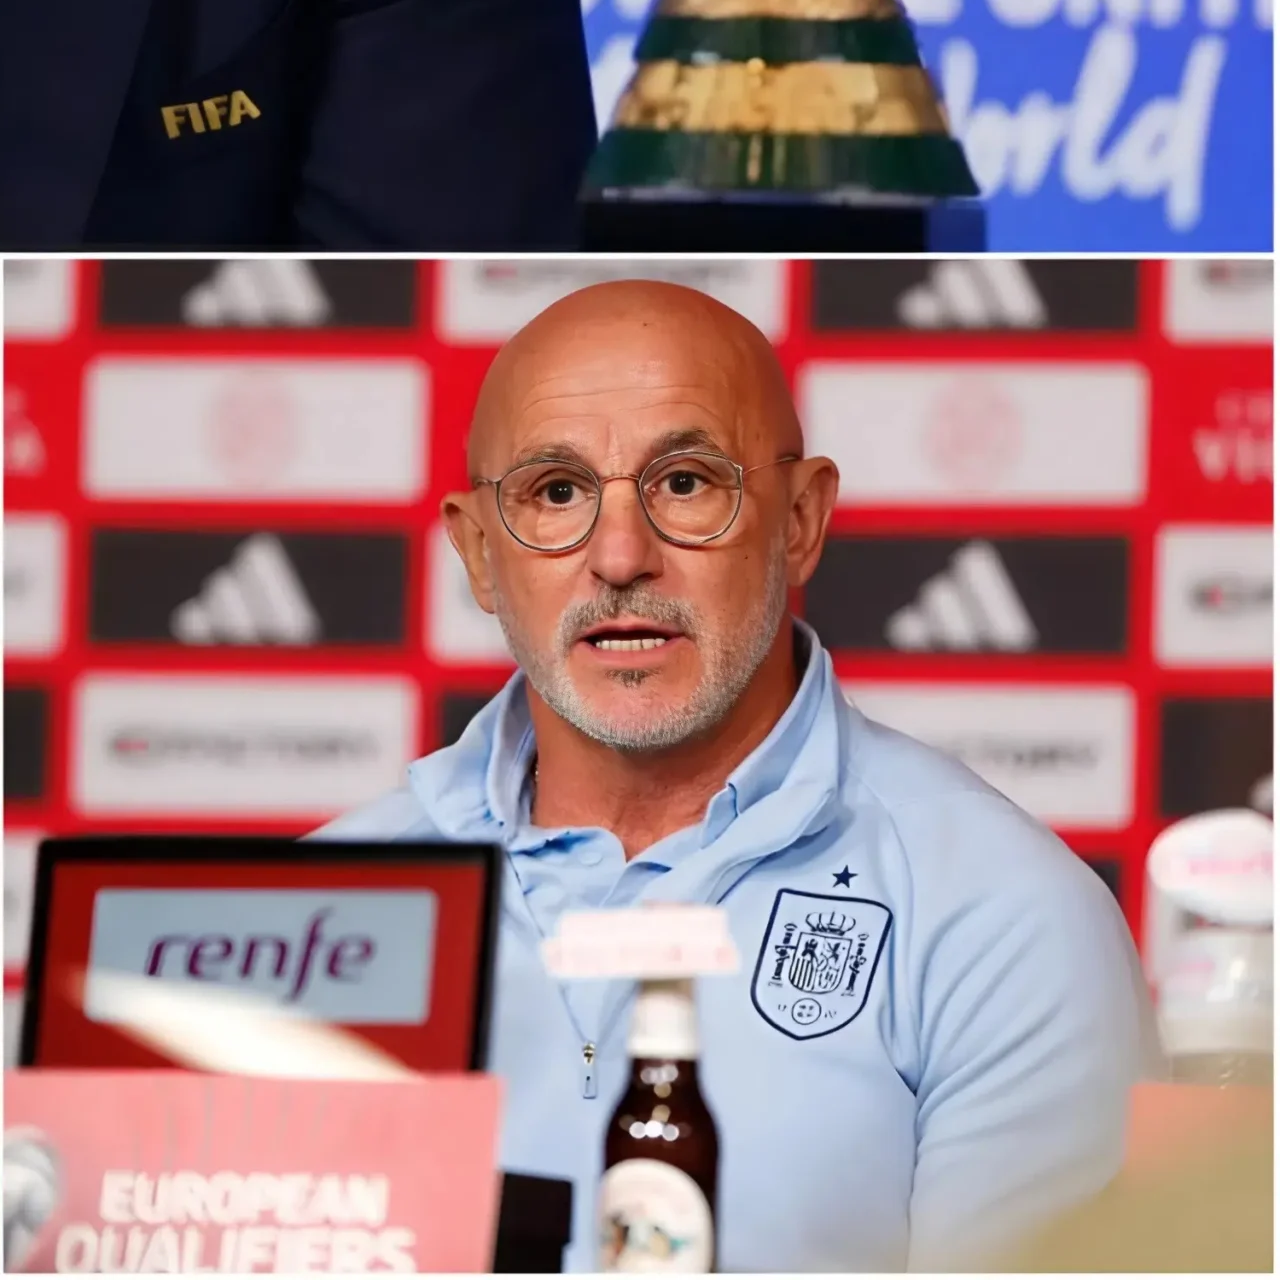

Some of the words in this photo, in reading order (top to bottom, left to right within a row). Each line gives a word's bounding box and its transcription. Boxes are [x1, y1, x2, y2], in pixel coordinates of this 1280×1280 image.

[160, 89, 262, 140] FIFA
[144, 905, 378, 1005] renfe
[99, 1169, 390, 1225] EUROPEAN
[54, 1224, 419, 1274] QUALIFIERS
